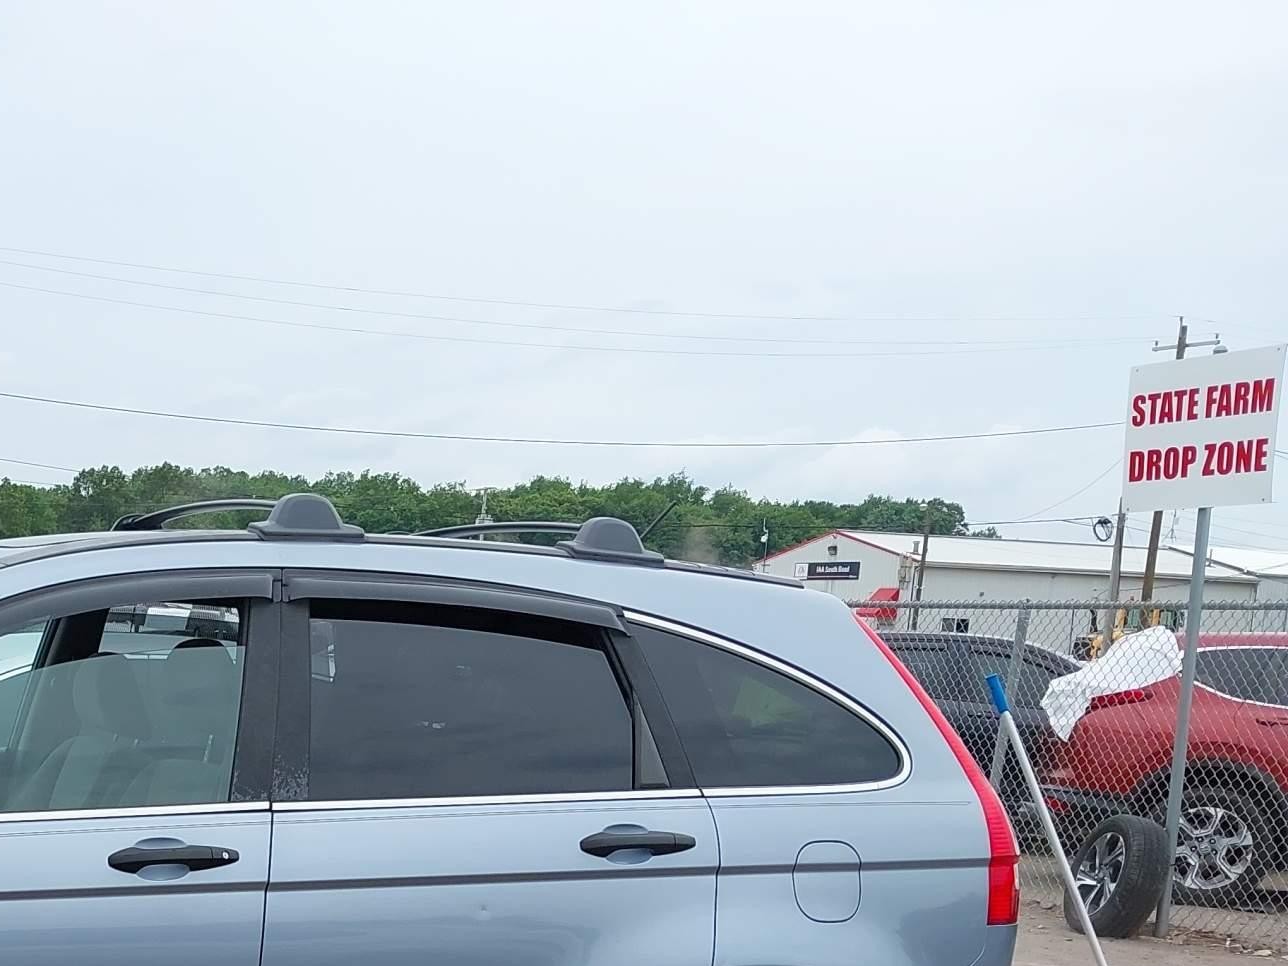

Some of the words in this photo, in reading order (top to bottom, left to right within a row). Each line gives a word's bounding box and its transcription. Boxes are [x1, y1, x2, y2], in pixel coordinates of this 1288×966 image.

[1132, 388, 1200, 427] STATE
[1205, 378, 1275, 418] FARM
[1129, 446, 1197, 482] DROP
[1202, 438, 1269, 476] ZONE
